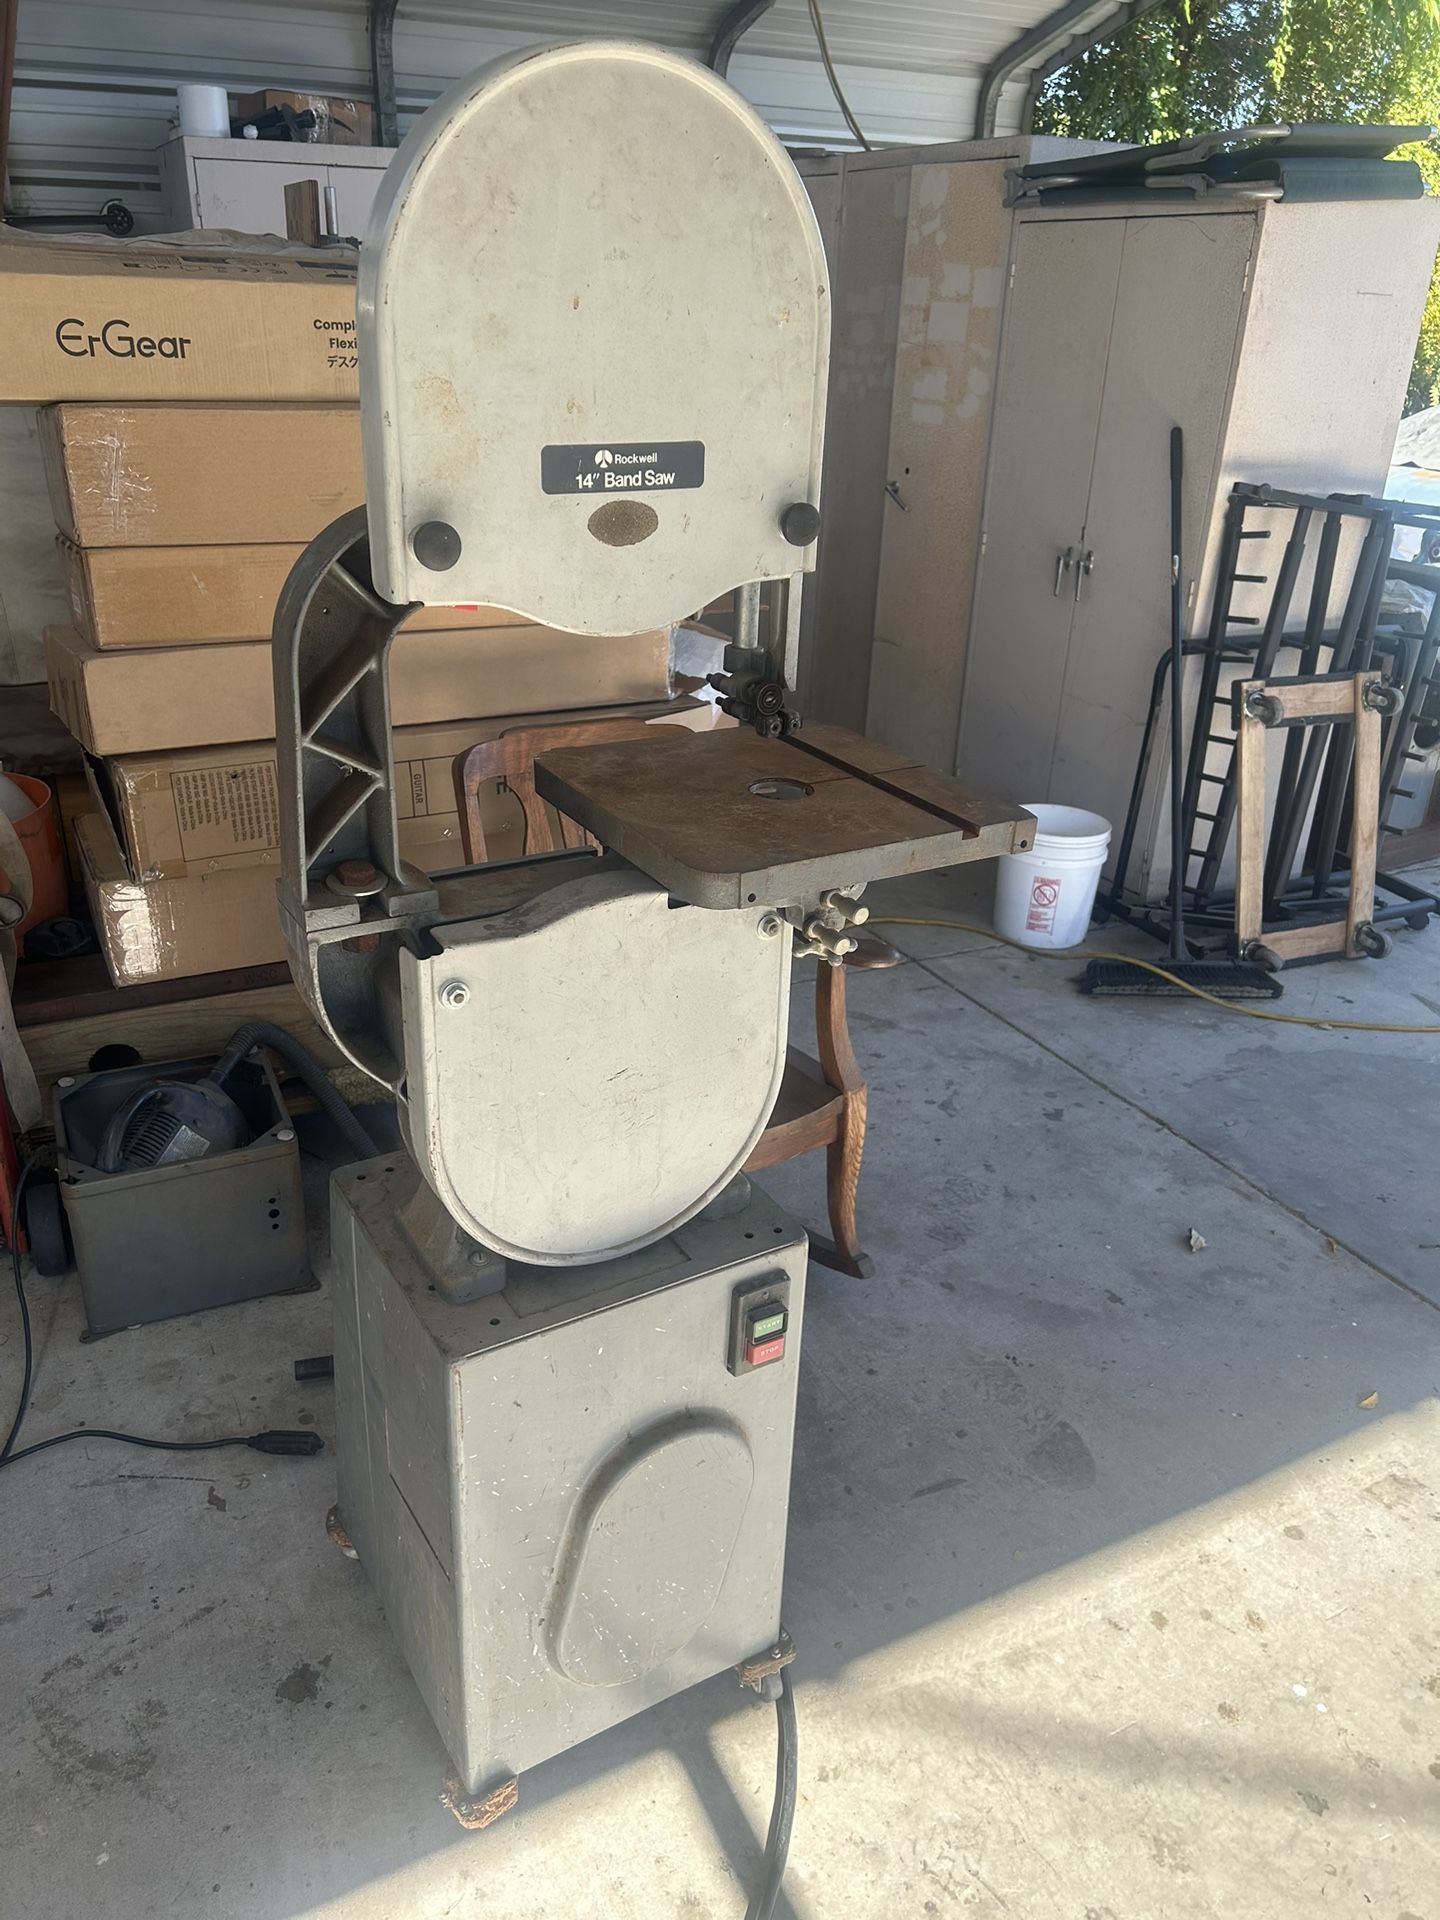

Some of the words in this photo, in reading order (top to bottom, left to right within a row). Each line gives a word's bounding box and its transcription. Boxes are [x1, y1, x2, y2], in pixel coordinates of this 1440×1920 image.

[55, 318, 192, 359] ErGear
[614, 452, 658, 465] Rockwell
[604, 470, 642, 488] Band
[644, 469, 676, 486] Saw
[413, 773, 424, 804] GUITAR
[760, 1346, 779, 1356] STOP
